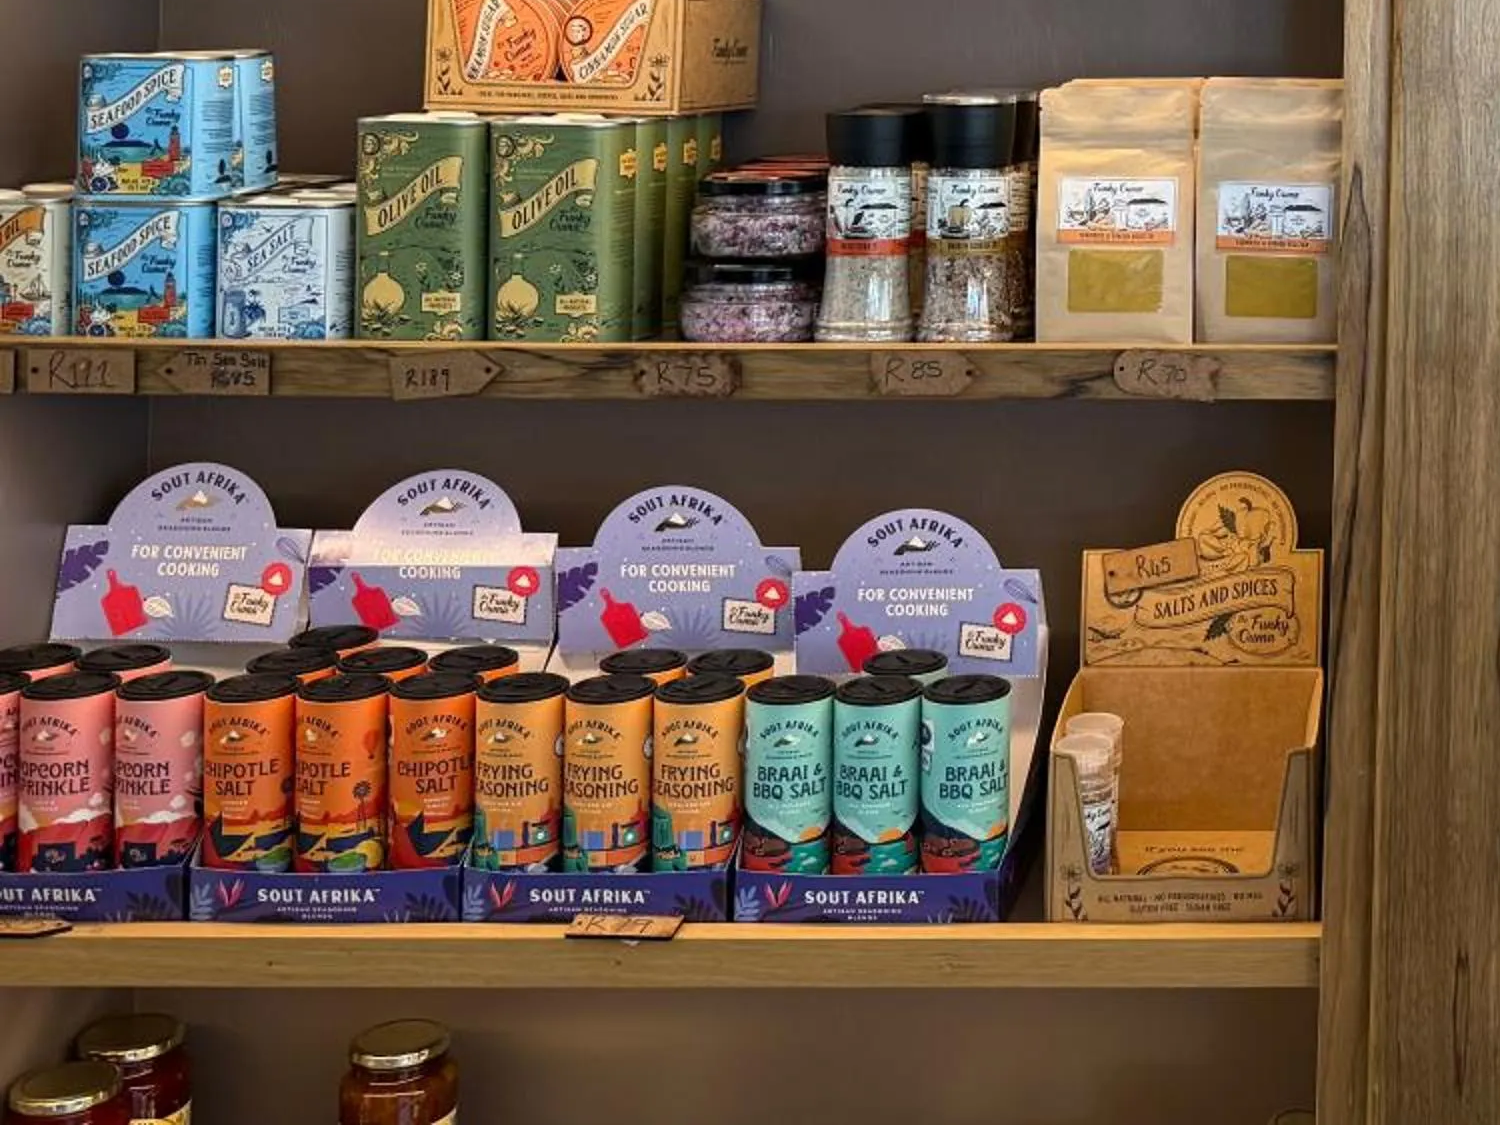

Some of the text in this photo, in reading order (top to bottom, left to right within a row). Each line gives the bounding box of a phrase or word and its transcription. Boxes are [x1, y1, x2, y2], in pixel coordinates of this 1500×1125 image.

[578, 2, 648, 79] CINNAMON SUGAR
[90, 68, 177, 127] SEAFOOD SPICE
[377, 164, 443, 228] OLIVE OIL
[512, 166, 578, 230] OLIVE OIL
[87, 216, 171, 276] SEAFOOD SPICE
[247, 225, 296, 271] SEA SALT
[151, 471, 245, 504] SOUT AFRIKA
[397, 478, 492, 509] SOUT AFRIKA
[628, 494, 722, 526] SOUT AFRIKA
[867, 517, 964, 548] SOUT AFRIKA
[131, 545, 248, 562] FOR CONVENIENT
[157, 561, 220, 578] COOKING
[399, 565, 461, 580] COOKING
[620, 563, 736, 579] FOR CONVENIENT
[648, 579, 711, 593] COOKING
[858, 587, 974, 603] FOR CONVENIENT
[1154, 578, 1278, 619] SALTS AND SPICES
[885, 603, 948, 618] COOKING
[1251, 614, 1289, 636] Funky
[22, 760, 89, 778] OPCORN
[477, 761, 533, 780] FRYING
[567, 763, 623, 780] FRYING
[661, 763, 720, 780] FRYING
[758, 765, 808, 782] BRAAI
[840, 765, 887, 782] BRAAI
[945, 764, 996, 782] BRAAI
[215, 780, 255, 796] SALT
[416, 776, 457, 794] SALT
[753, 777, 828, 799] BBQ SALT
[836, 778, 908, 799] BBQ SALT
[939, 773, 1008, 799] BBQ SALT
[31, 888, 97, 902] AFRIKA
[257, 888, 375, 903] SOUT AFRIKA
[530, 889, 645, 903] SOUT AFRIKA
[805, 891, 919, 904] SOUT AFRIKA
